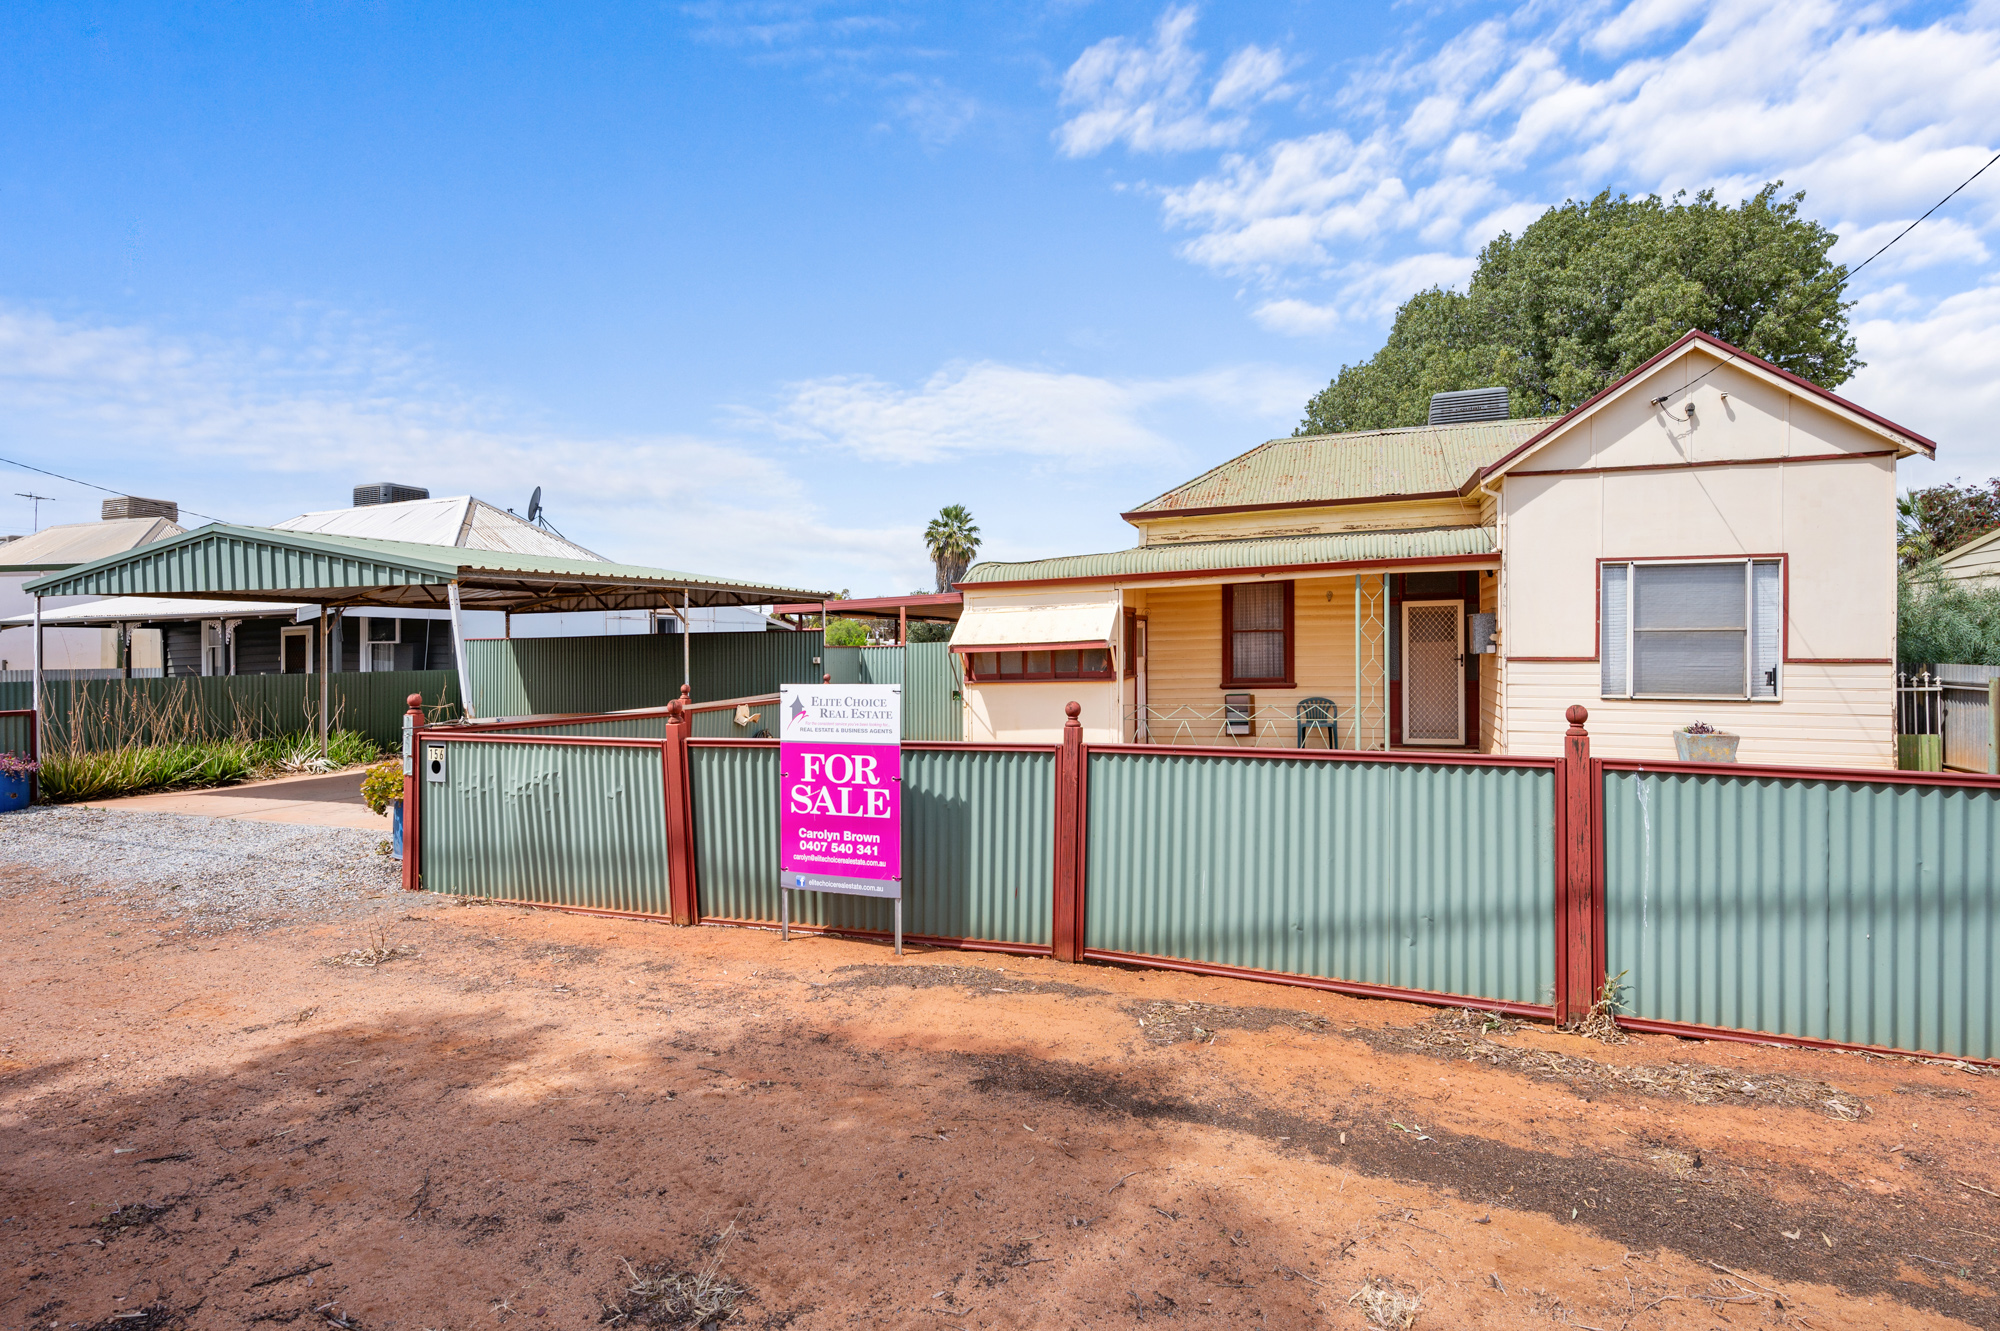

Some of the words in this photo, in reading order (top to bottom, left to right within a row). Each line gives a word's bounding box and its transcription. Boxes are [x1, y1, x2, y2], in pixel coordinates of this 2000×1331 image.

[811, 696, 842, 707] ELITE
[844, 696, 887, 708] CHOICE
[820, 708, 849, 719] REAL
[851, 708, 893, 720] ESTATE
[430, 749, 443, 760] 156
[800, 753, 880, 785] FOR
[790, 784, 891, 818] SALE
[798, 828, 840, 843] Carolyn
[843, 830, 880, 843] Brown
[799, 840, 828, 852] 0407
[831, 843, 853, 854] 540
[856, 845, 878, 856] 341
[793, 853, 886, 867] carolyn@elitechoicerealestate.com.au
[808, 879, 884, 892] elitechoicerealestate.com.au
